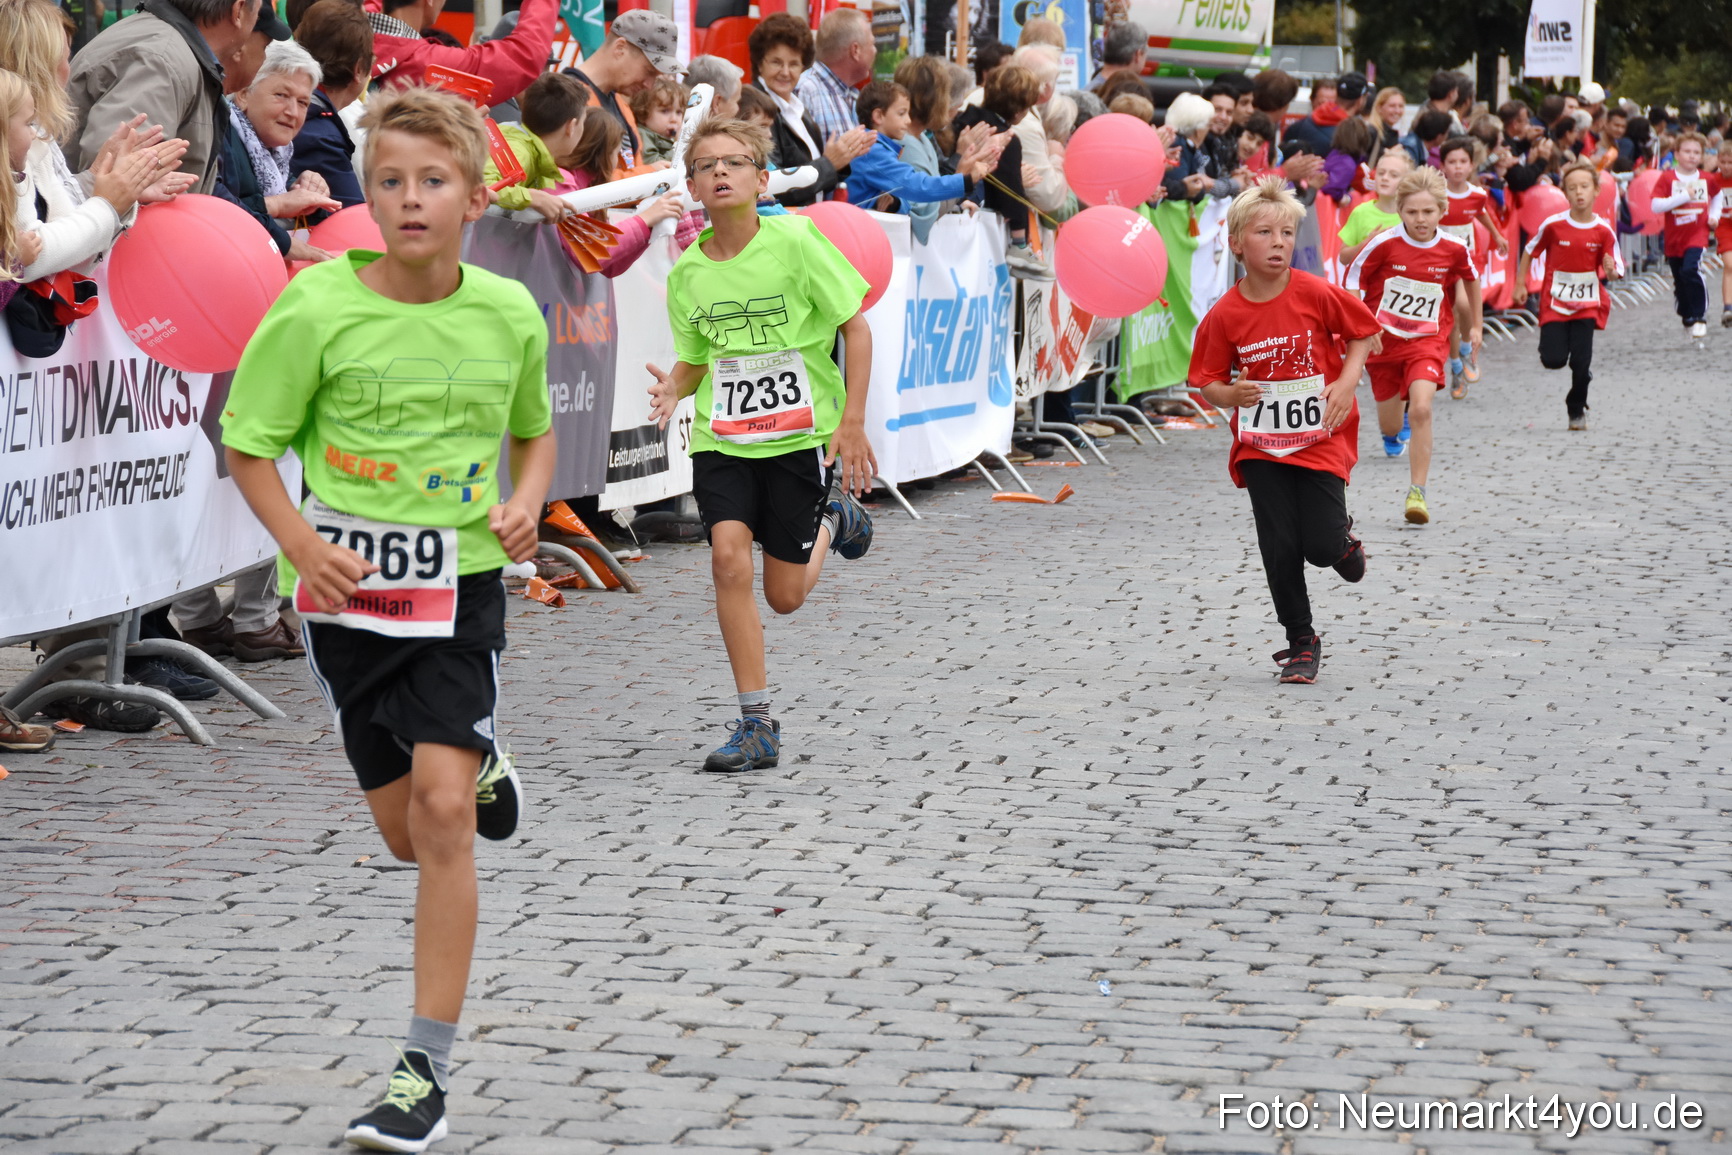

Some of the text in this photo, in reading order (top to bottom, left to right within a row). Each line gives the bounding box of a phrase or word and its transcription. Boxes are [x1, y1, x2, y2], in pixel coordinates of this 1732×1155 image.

[1558, 282, 1593, 299] 7131
[1389, 289, 1437, 318] 7221
[146, 325, 178, 347] energie
[1236, 336, 1289, 354] Neumarkter
[744, 351, 794, 372] BOCK
[1240, 348, 1278, 364] Stadtlauf
[722, 371, 801, 416] 7233
[1277, 379, 1319, 394] BOCK
[1252, 396, 1321, 429] 7166
[359, 424, 374, 434] und
[475, 430, 500, 439] GmbH
[747, 418, 777, 431] Paul
[1252, 434, 1318, 448] Maximilian
[325, 444, 399, 483] MERZ
[40, 467, 84, 524] MEHR
